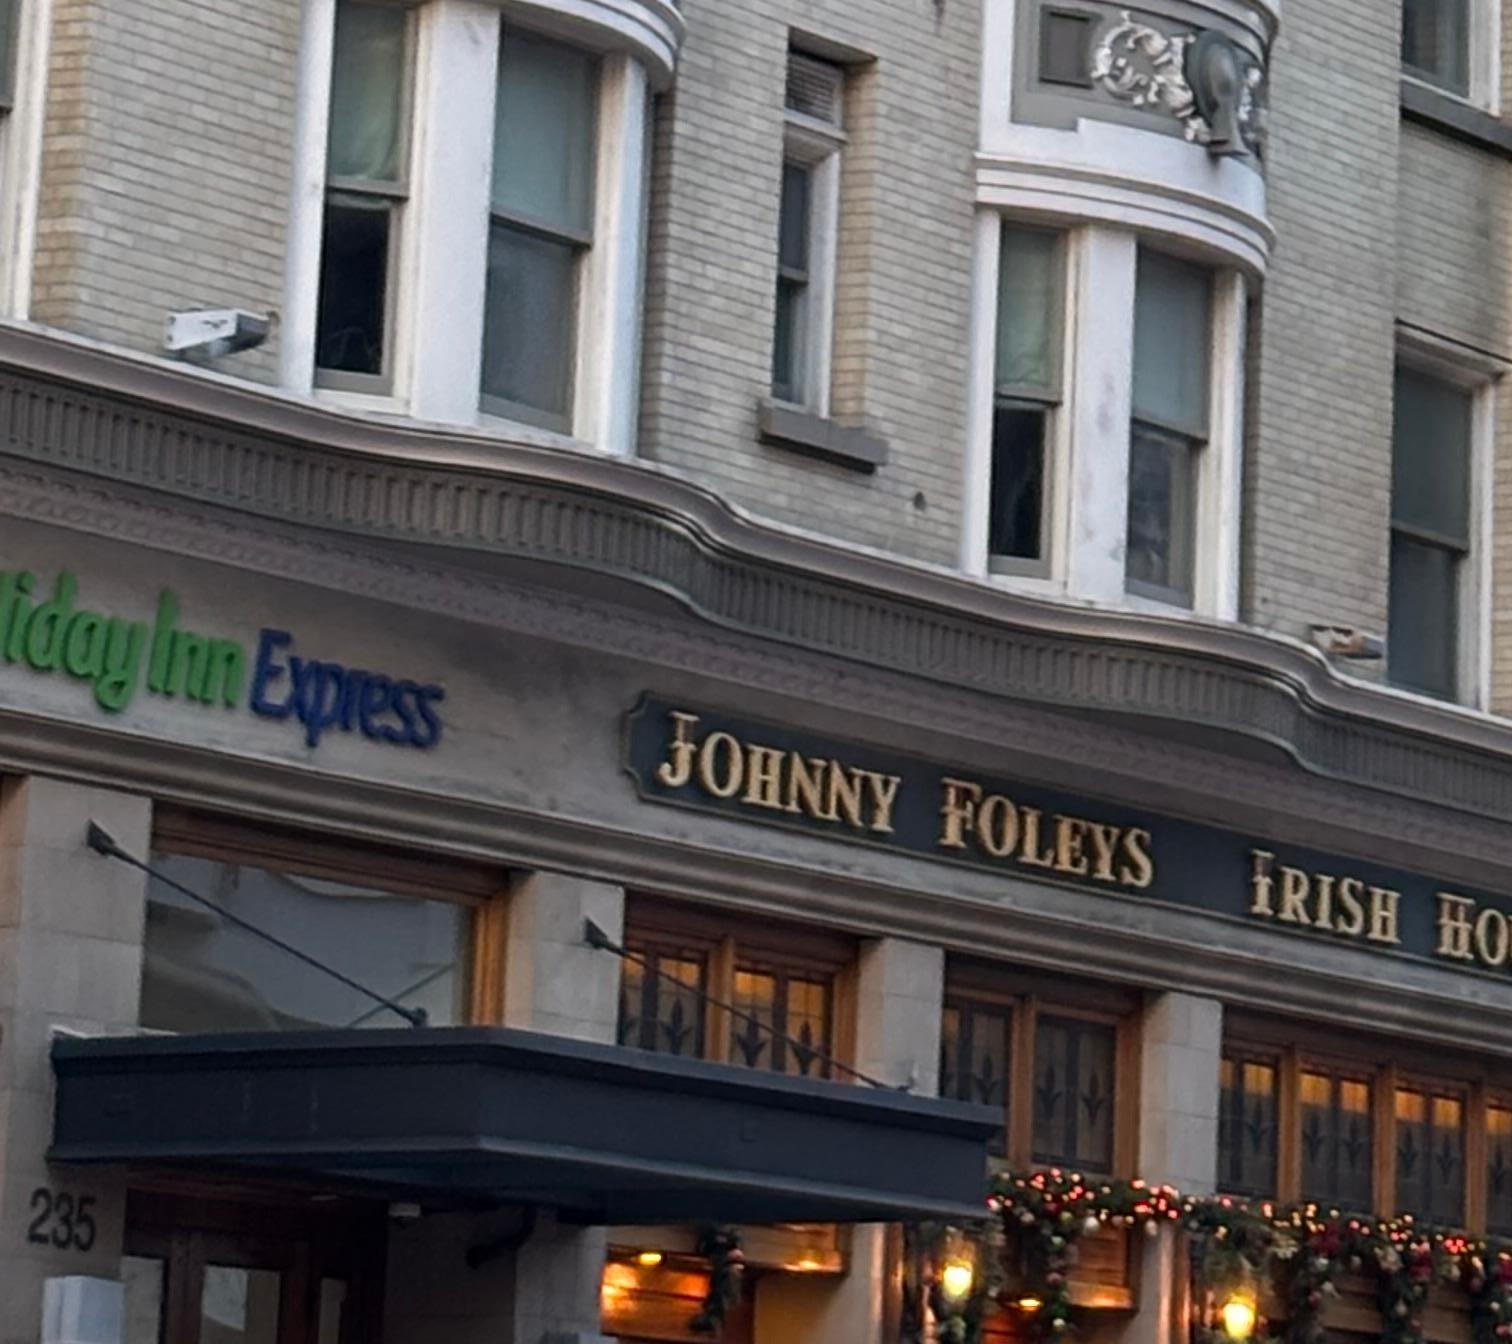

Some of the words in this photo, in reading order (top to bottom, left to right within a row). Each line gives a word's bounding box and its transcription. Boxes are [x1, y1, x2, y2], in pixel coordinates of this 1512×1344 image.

[148, 587, 245, 708] Inn
[250, 627, 446, 748] Express
[658, 711, 901, 833] JOHNNY
[938, 777, 1154, 889] FOLEYS
[1250, 848, 1401, 944] IRISH
[27, 1188, 97, 1252] 235
